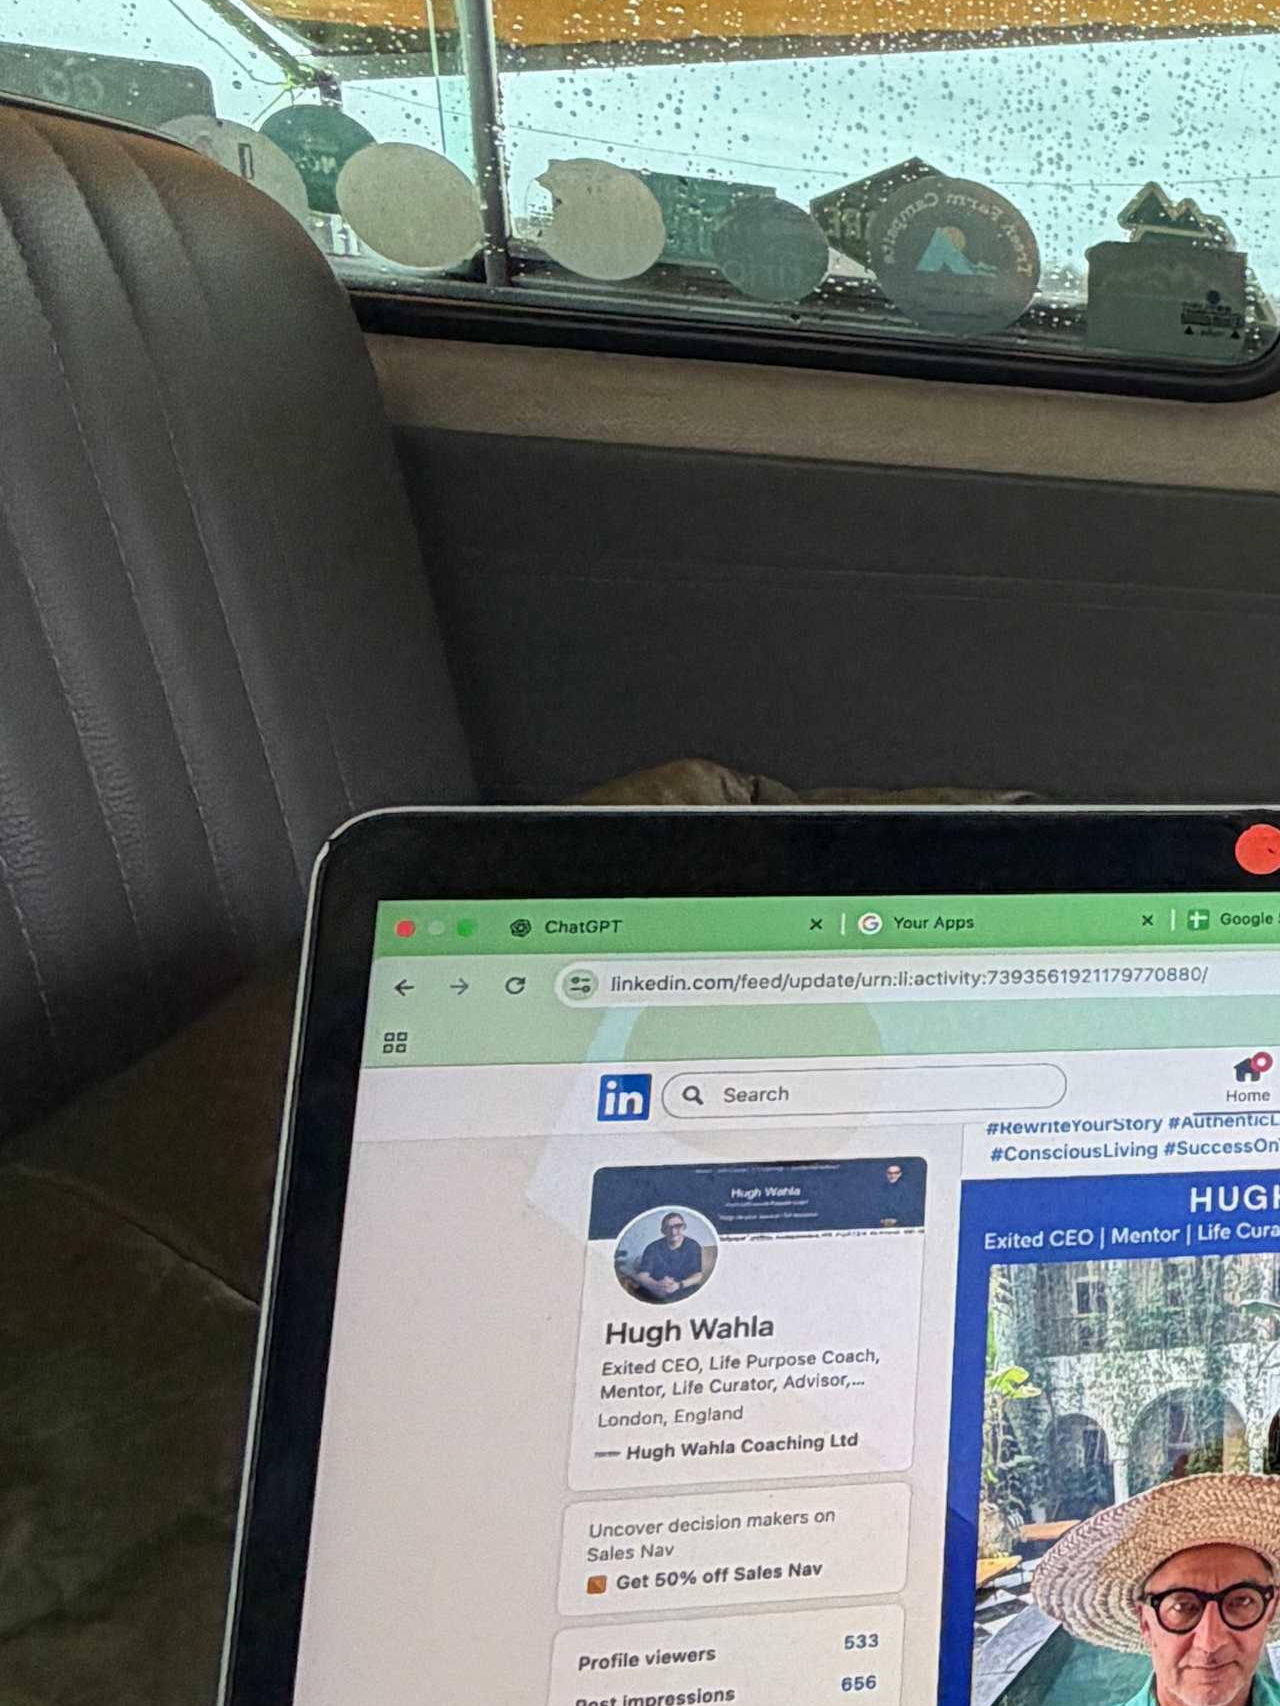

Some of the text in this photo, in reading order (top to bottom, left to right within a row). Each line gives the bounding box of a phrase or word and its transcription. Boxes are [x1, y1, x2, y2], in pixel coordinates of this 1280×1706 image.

[545, 919, 623, 935] ChatGPT
[894, 914, 975, 933] Your Apps
[1220, 911, 1273, 929] Google
[723, 1086, 790, 1104] Search
[1226, 1088, 1271, 1103] Home
[991, 1141, 1159, 1163] #ConsciousLiving
[984, 1231, 1044, 1250] Exited
[1050, 1228, 1094, 1247] CEO
[1111, 1227, 1180, 1245] Mentor
[1198, 1223, 1231, 1242] Life
[605, 1314, 775, 1347] Hugh Wahla
[602, 1347, 881, 1377] Exited CEO, Life Purpose Coach,
[600, 1383, 666, 1400] Mentor,
[672, 1379, 704, 1395] Life
[709, 1376, 778, 1395] Curator,
[598, 1405, 744, 1428] London, England
[626, 1443, 676, 1462] Hugh
[680, 1439, 736, 1457] Wahla
[741, 1435, 825, 1456] Coaching
[830, 1432, 859, 1448] Ltd
[589, 1509, 836, 1540] Uncover decision makers on
[587, 1543, 675, 1563] Sales Nav
[616, 1561, 824, 1591] Get 50% off Sales Nav
[843, 1633, 880, 1650] 533
[578, 1647, 717, 1671] Profile viewers
[840, 1675, 878, 1692] 656
